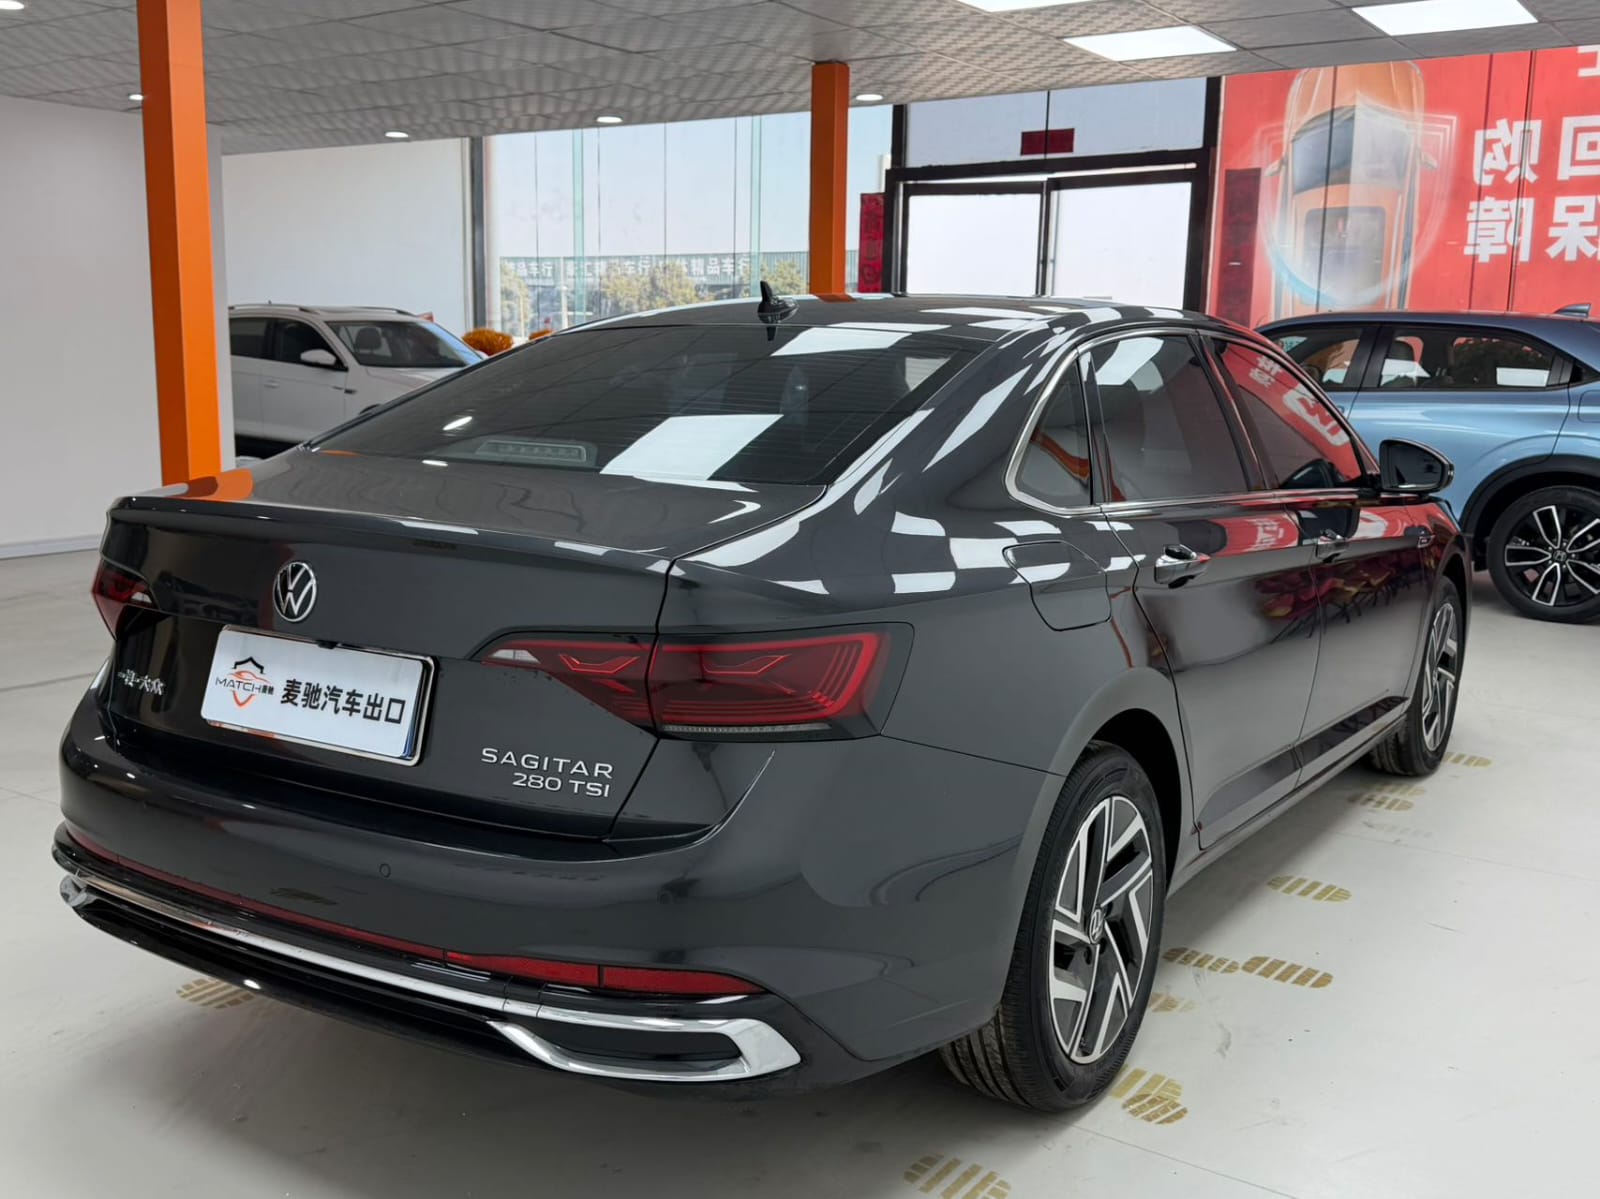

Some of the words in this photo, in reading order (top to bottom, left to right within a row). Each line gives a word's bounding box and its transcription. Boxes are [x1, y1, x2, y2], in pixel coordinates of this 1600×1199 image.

[215, 677, 262, 694] MATCH
[280, 678, 406, 725] 麦驰汽车出口
[481, 747, 614, 779] SAGITAR
[512, 772, 562, 792] 280
[568, 779, 610, 797] TSI
